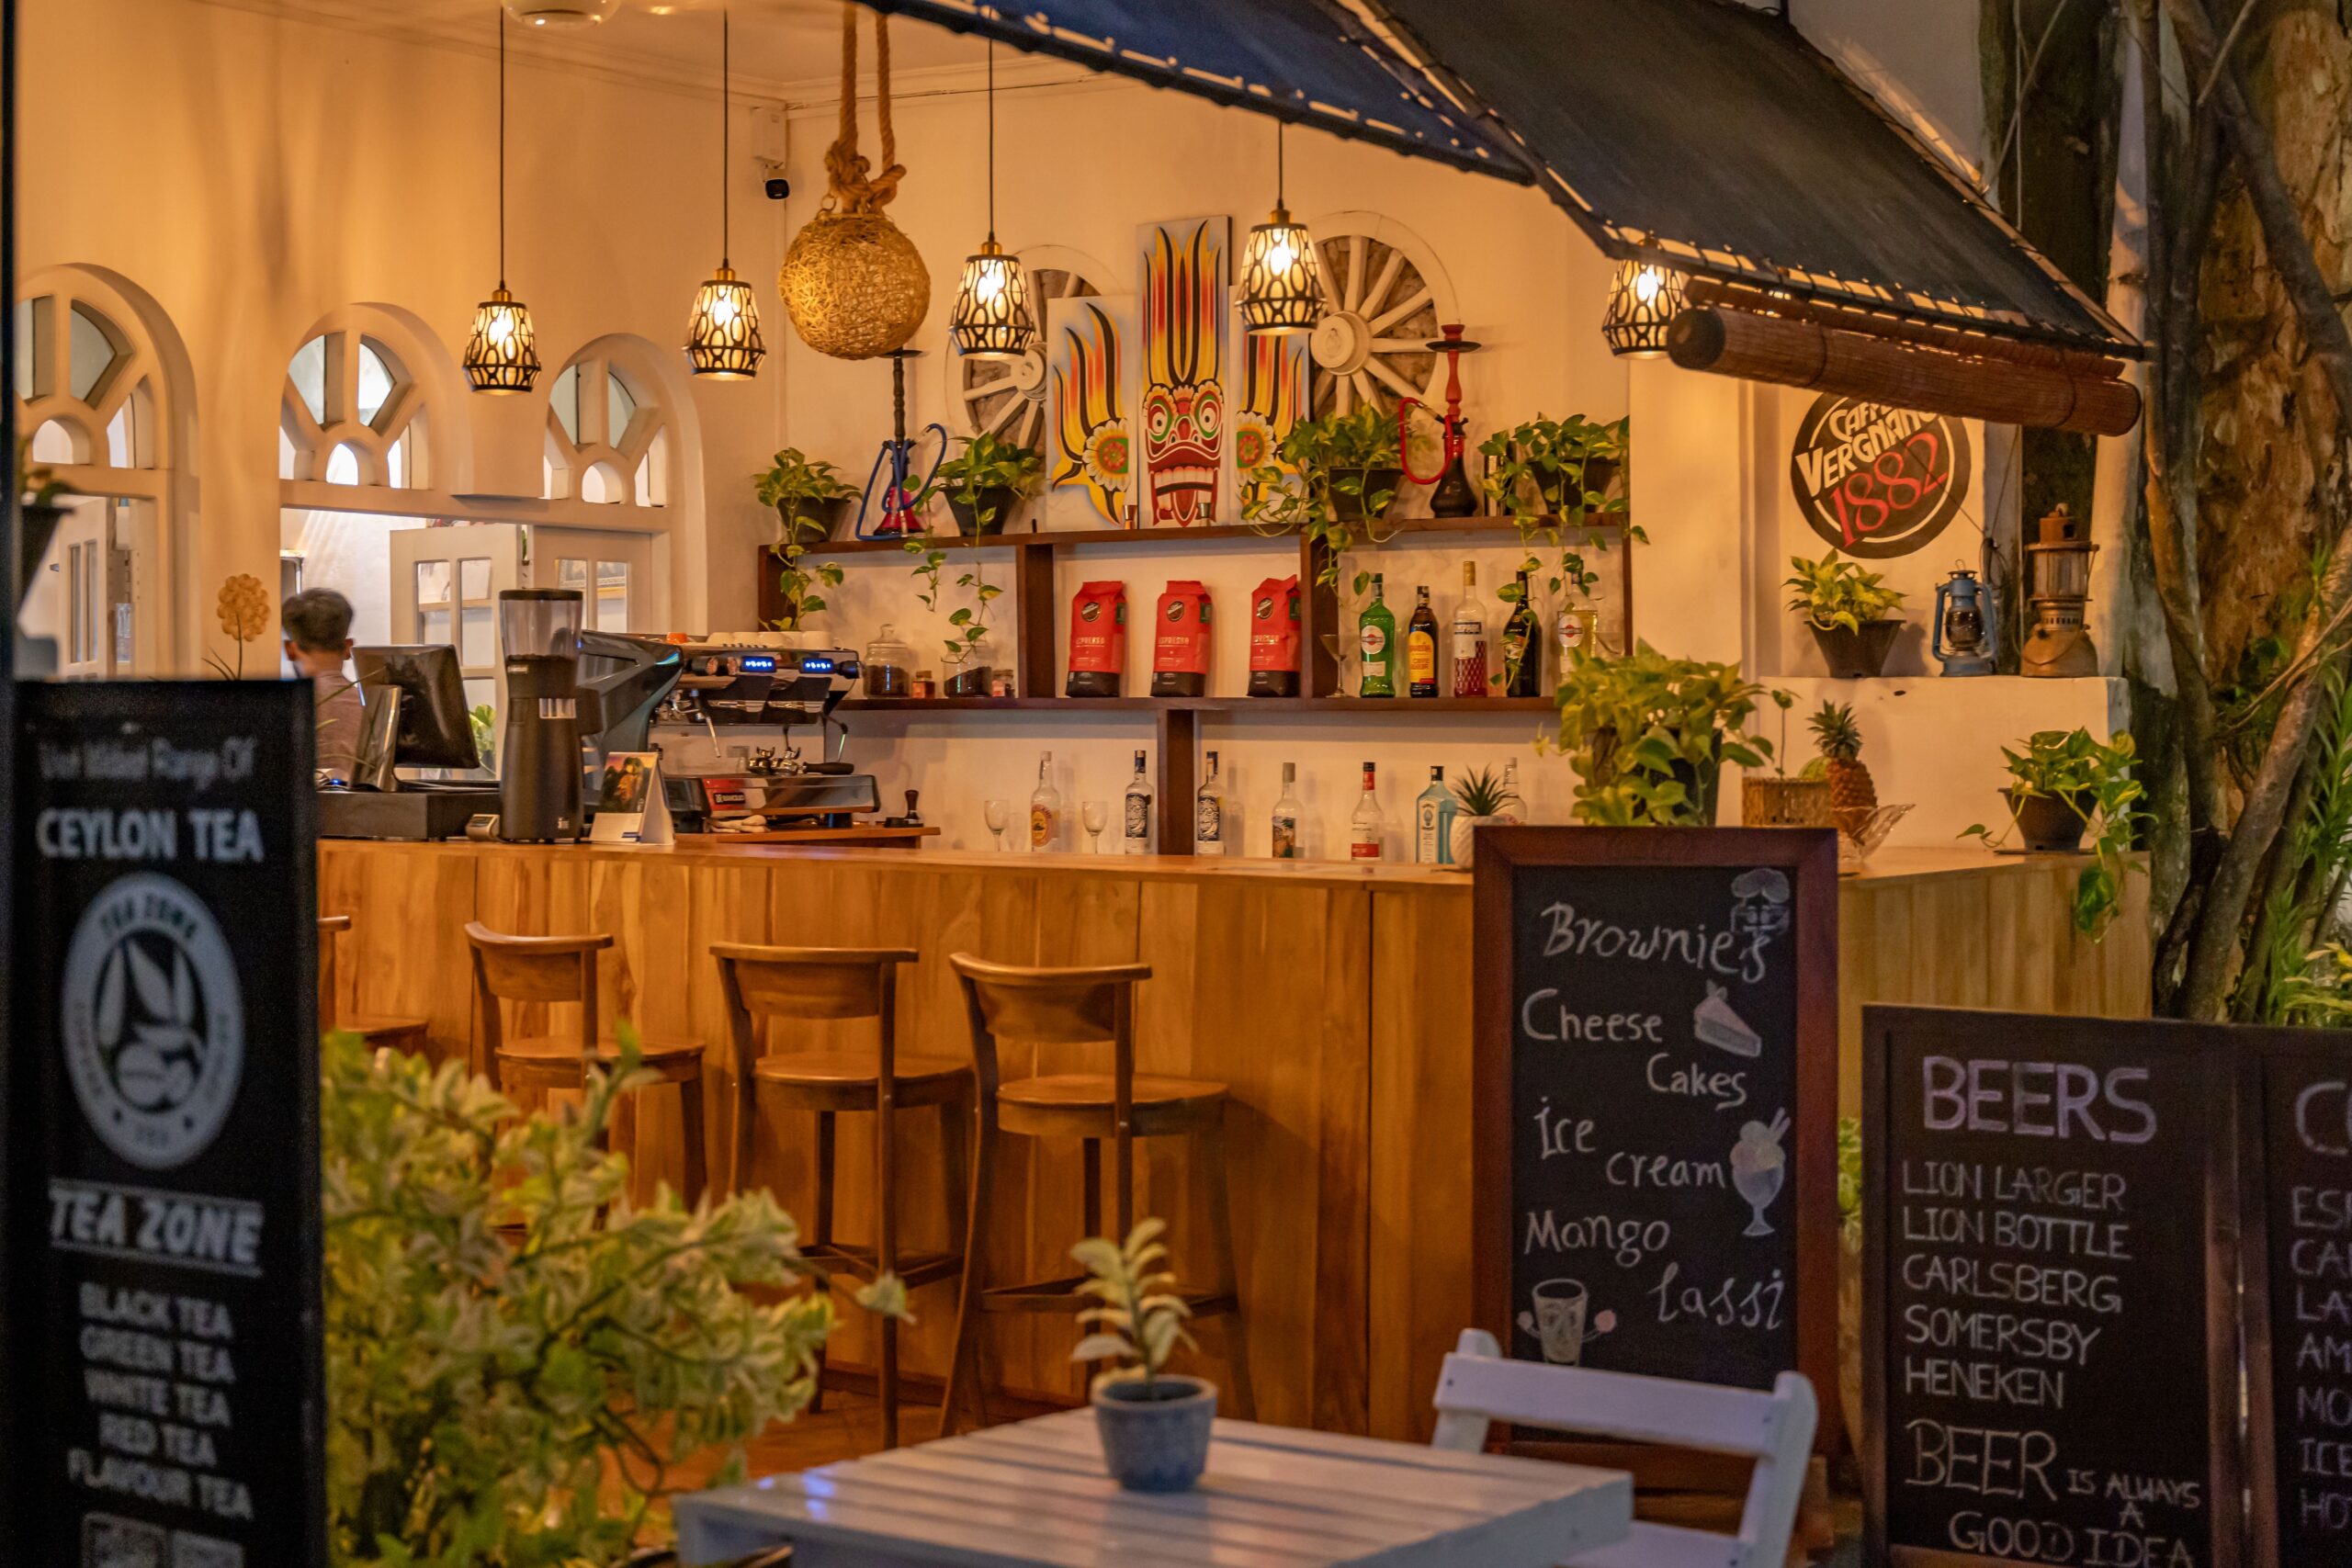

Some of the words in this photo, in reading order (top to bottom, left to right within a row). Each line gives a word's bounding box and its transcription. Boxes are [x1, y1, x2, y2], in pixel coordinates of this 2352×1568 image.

[1828, 401, 1893, 443] CAFF
[1830, 432, 1949, 548] 1882
[35, 807, 177, 859] CEYLON
[188, 808, 265, 863] TEA
[1540, 900, 1772, 985] Brownies
[1521, 988, 1664, 1043] Cheese
[1646, 1053, 1747, 1111] Cakes
[1923, 1055, 2157, 1144] BEERS
[1533, 1096, 1598, 1160] Ice
[1902, 1159, 1983, 1200] LION
[1994, 1165, 2127, 1211] LARGER
[49, 1186, 127, 1246] TEA
[137, 1196, 265, 1264] ZONE
[1524, 1210, 1671, 1268] Mango
[1902, 1205, 1984, 1244] LION
[1994, 1210, 2132, 1259] BOTTLE
[79, 1280, 174, 1330] BLACK
[176, 1294, 234, 1337] TEA
[1903, 1253, 2122, 1314] CARLSBERG
[178, 1338, 236, 1382] TEA
[1904, 1304, 2101, 1366] SOMERSBY
[175, 1382, 230, 1427] TEA
[1904, 1355, 2064, 1408] HENEKEN
[161, 1423, 218, 1470] TEA
[1905, 1418, 2058, 1501] BEER
[2067, 1469, 2097, 1495] IS
[2105, 1473, 2200, 1509] ALWAYS
[196, 1472, 254, 1520] TEA
[2118, 1500, 2145, 1529] A
[2300, 1486, 2352, 1529] HO
[1948, 1510, 2075, 1562] GOOD
